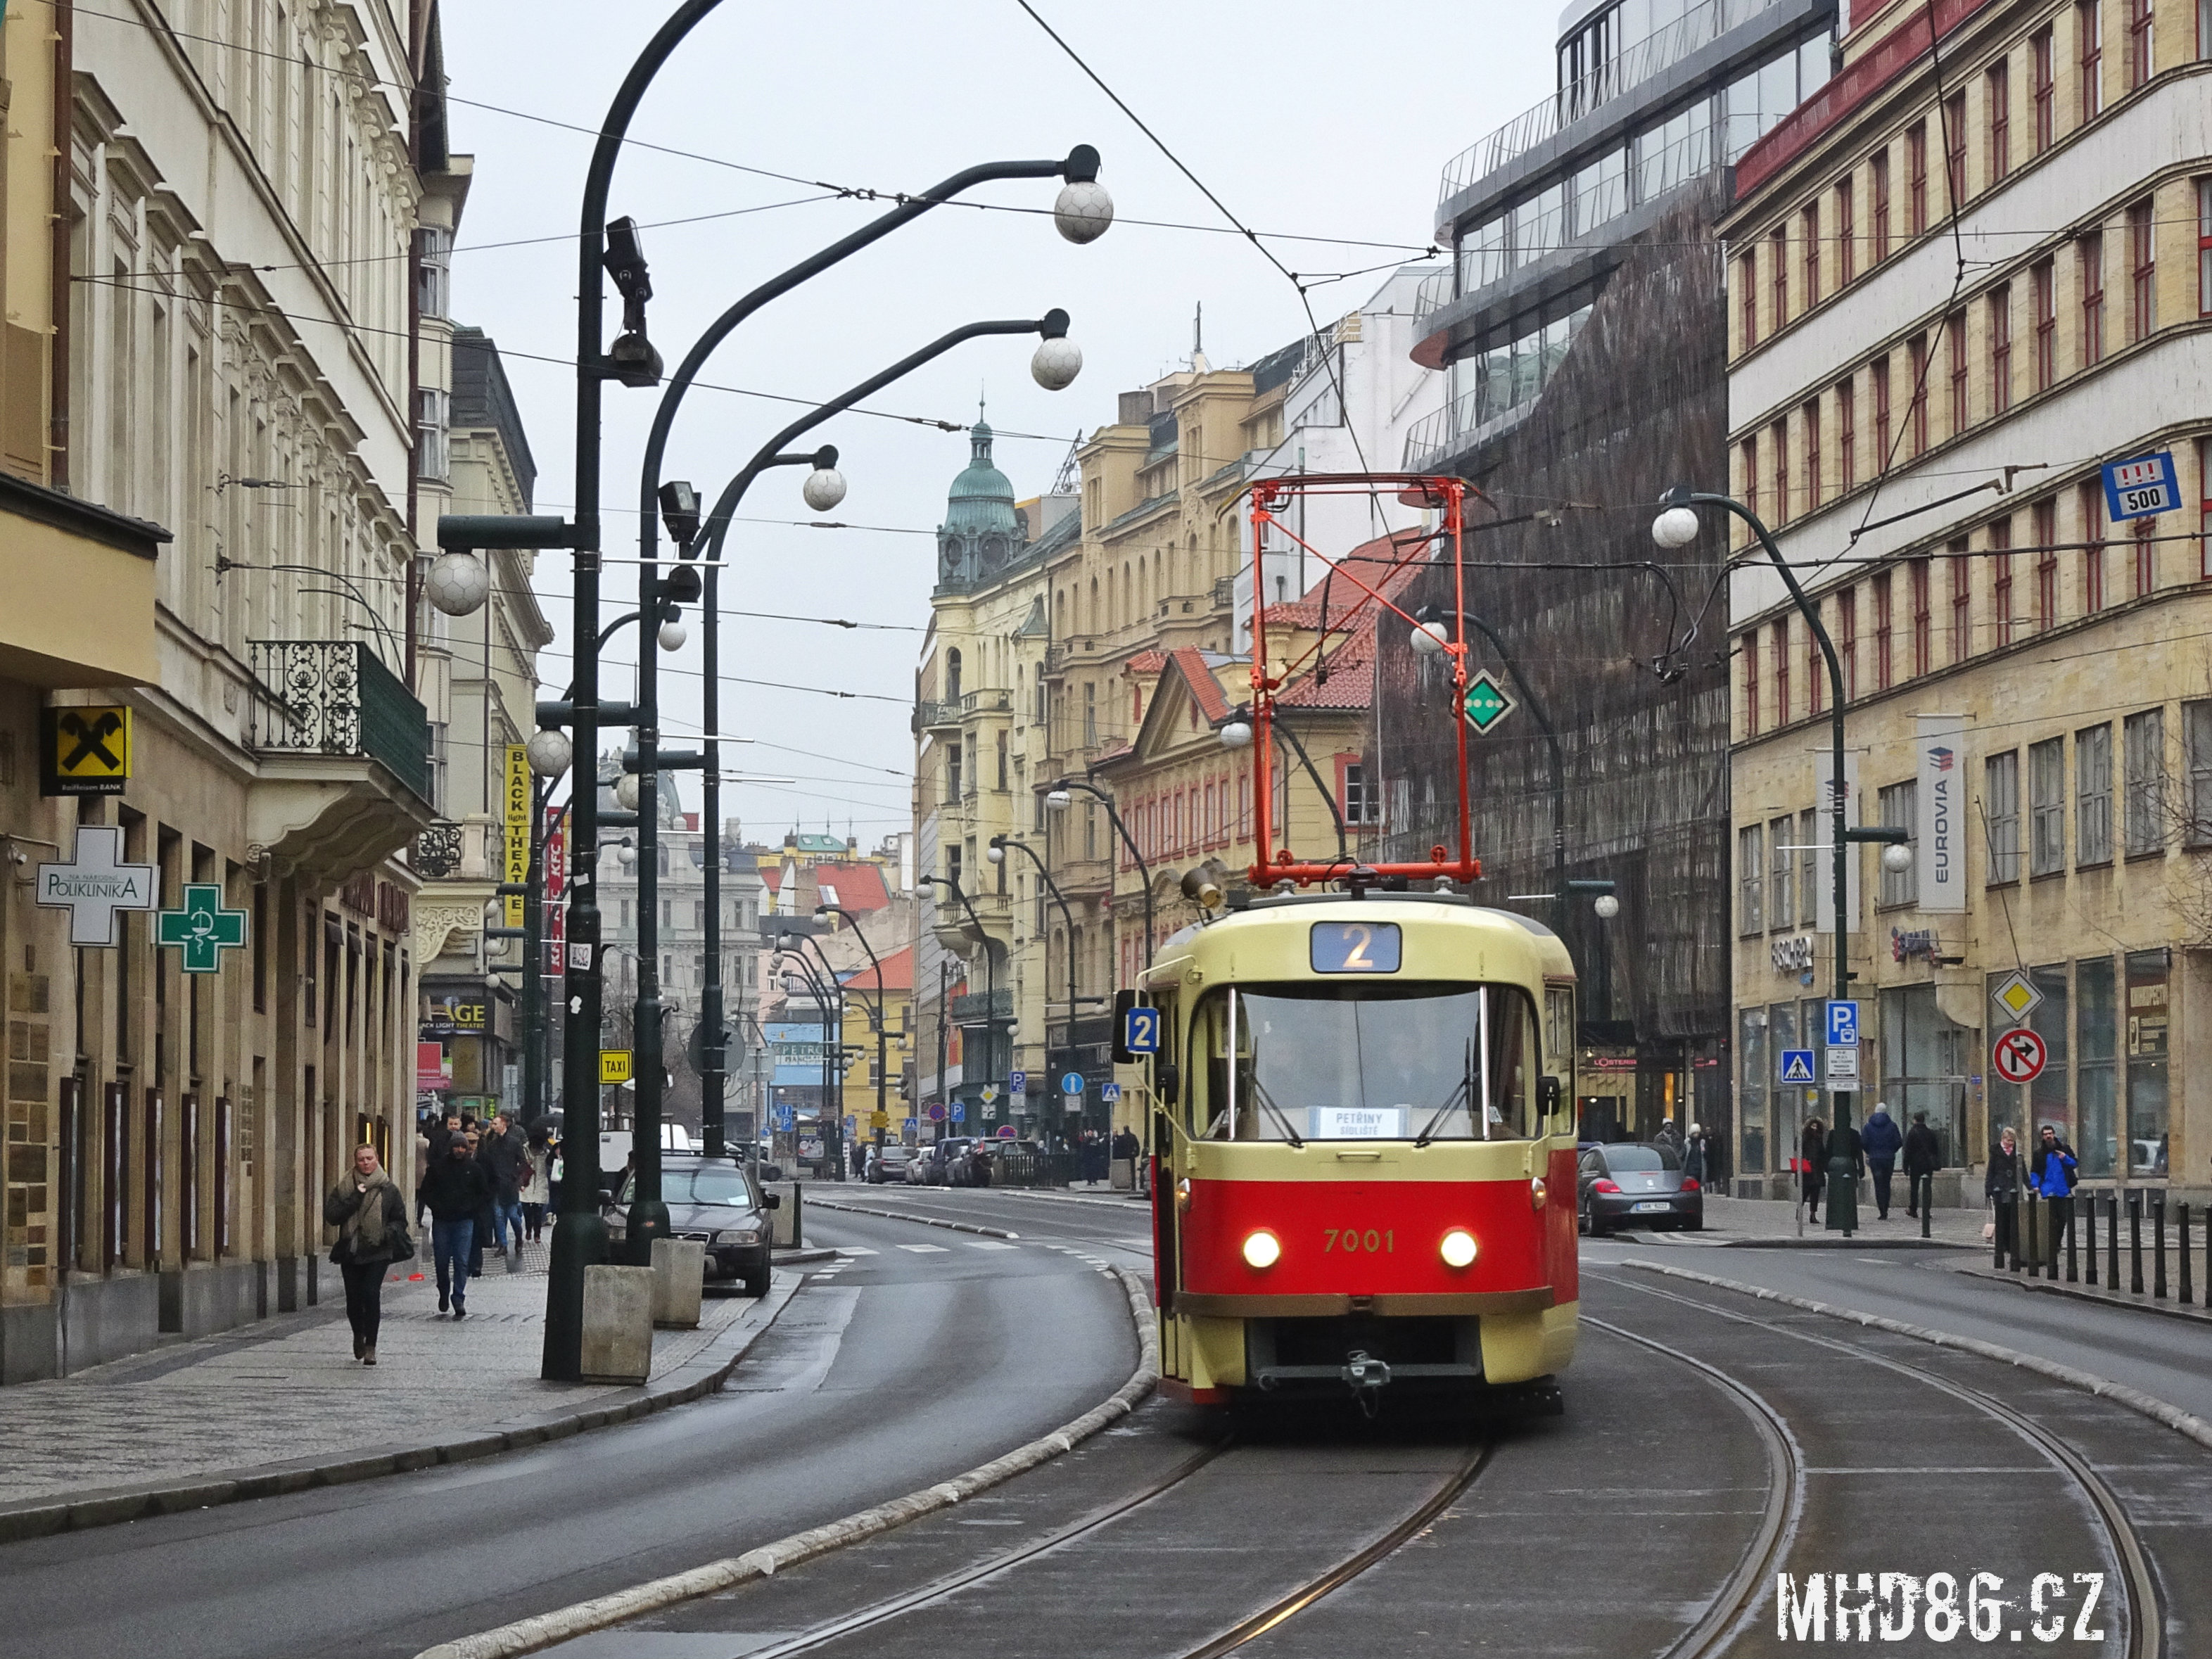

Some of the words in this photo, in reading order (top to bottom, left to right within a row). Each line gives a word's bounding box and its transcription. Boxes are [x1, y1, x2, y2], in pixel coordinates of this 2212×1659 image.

[2127, 488, 2161, 511] 500
[511, 751, 524, 811] BLACK
[507, 813, 527, 822] light
[1935, 778, 1948, 883] EUROVIA
[511, 825, 523, 910] THEATE
[550, 843, 561, 877] KFC
[1342, 923, 1373, 968] 2
[1134, 1015, 1151, 1046] 2
[1833, 1006, 1852, 1032] P
[782, 1044, 829, 1055] PETRO
[605, 1061, 625, 1073] TAXI
[1013, 1074, 1023, 1086] P
[783, 1117, 789, 1127] P
[953, 1105, 962, 1116] P
[1337, 1112, 1382, 1124] PETŘINY
[1324, 1229, 1394, 1253] 7001
